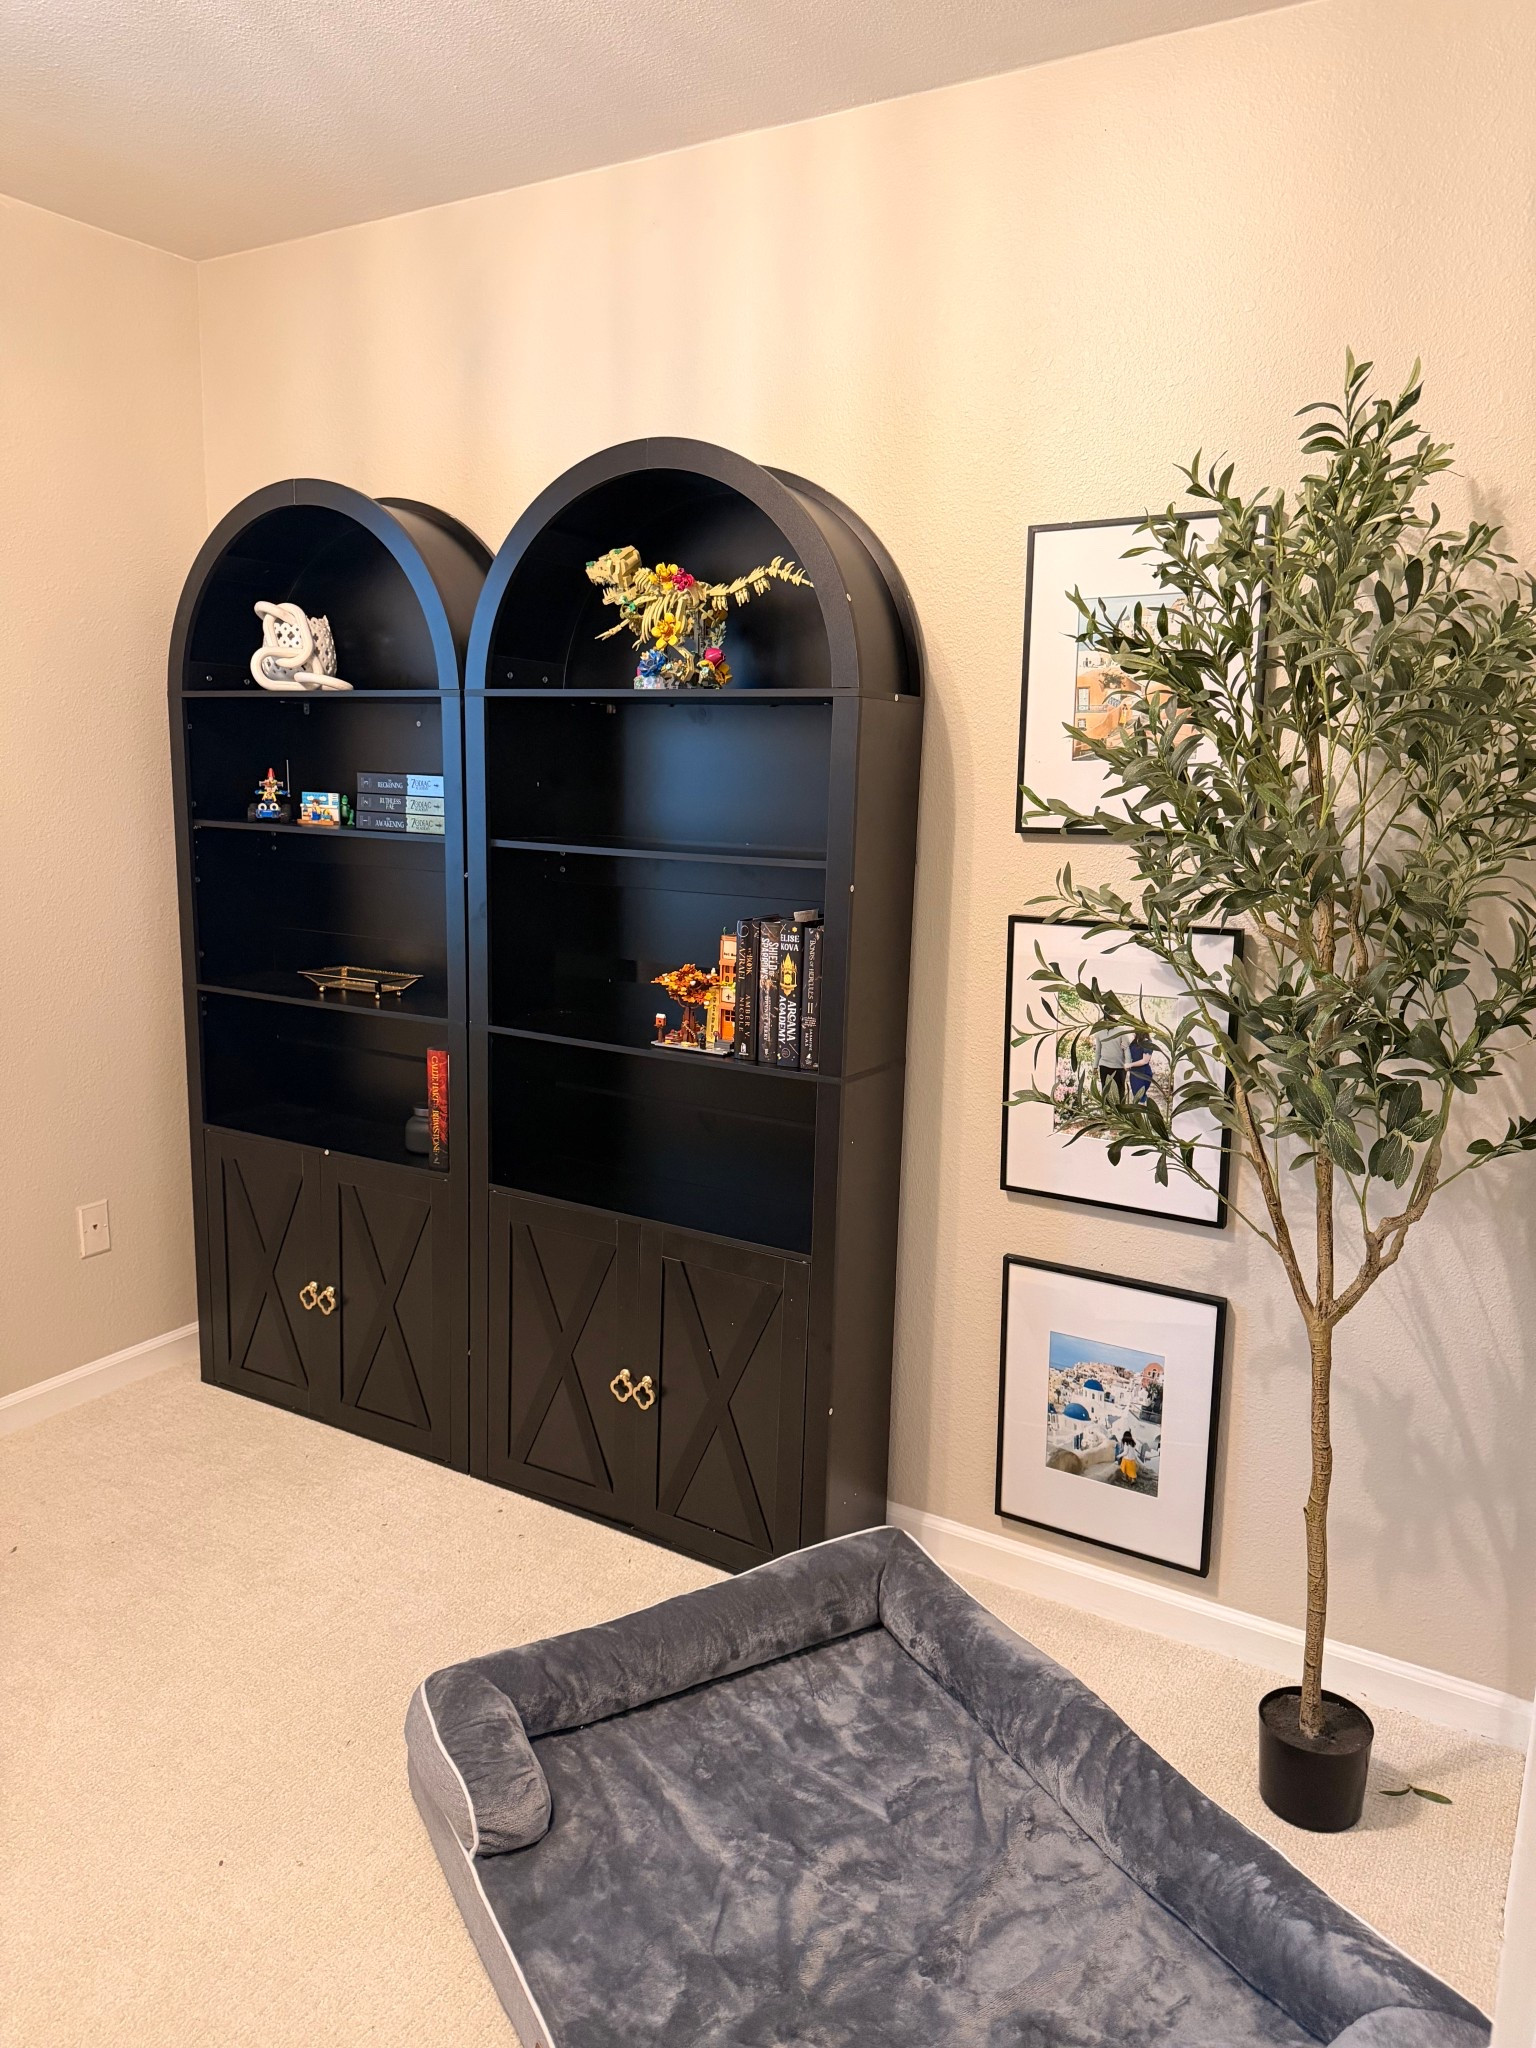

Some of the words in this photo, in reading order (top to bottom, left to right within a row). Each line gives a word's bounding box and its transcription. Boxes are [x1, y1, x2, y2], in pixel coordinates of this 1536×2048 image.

[377, 781, 403, 789] RECKONING
[380, 797, 401, 805] RUTHLESS
[375, 819, 405, 829] AWAKENING
[780, 933, 800, 943] ELISE
[780, 942, 799, 952] KOVA
[738, 945, 746, 982] AZRAEL
[745, 954, 753, 976] BOOK
[760, 937, 770, 980] SPARROWS
[768, 941, 779, 971] SHIELD
[807, 968, 815, 1000] HERCULES
[778, 994, 787, 1044] ACADEMY
[786, 1000, 797, 1042] ARCANA
[431, 1055, 439, 1081] CALLIE
[432, 1110, 440, 1153] BRIMSTONE
